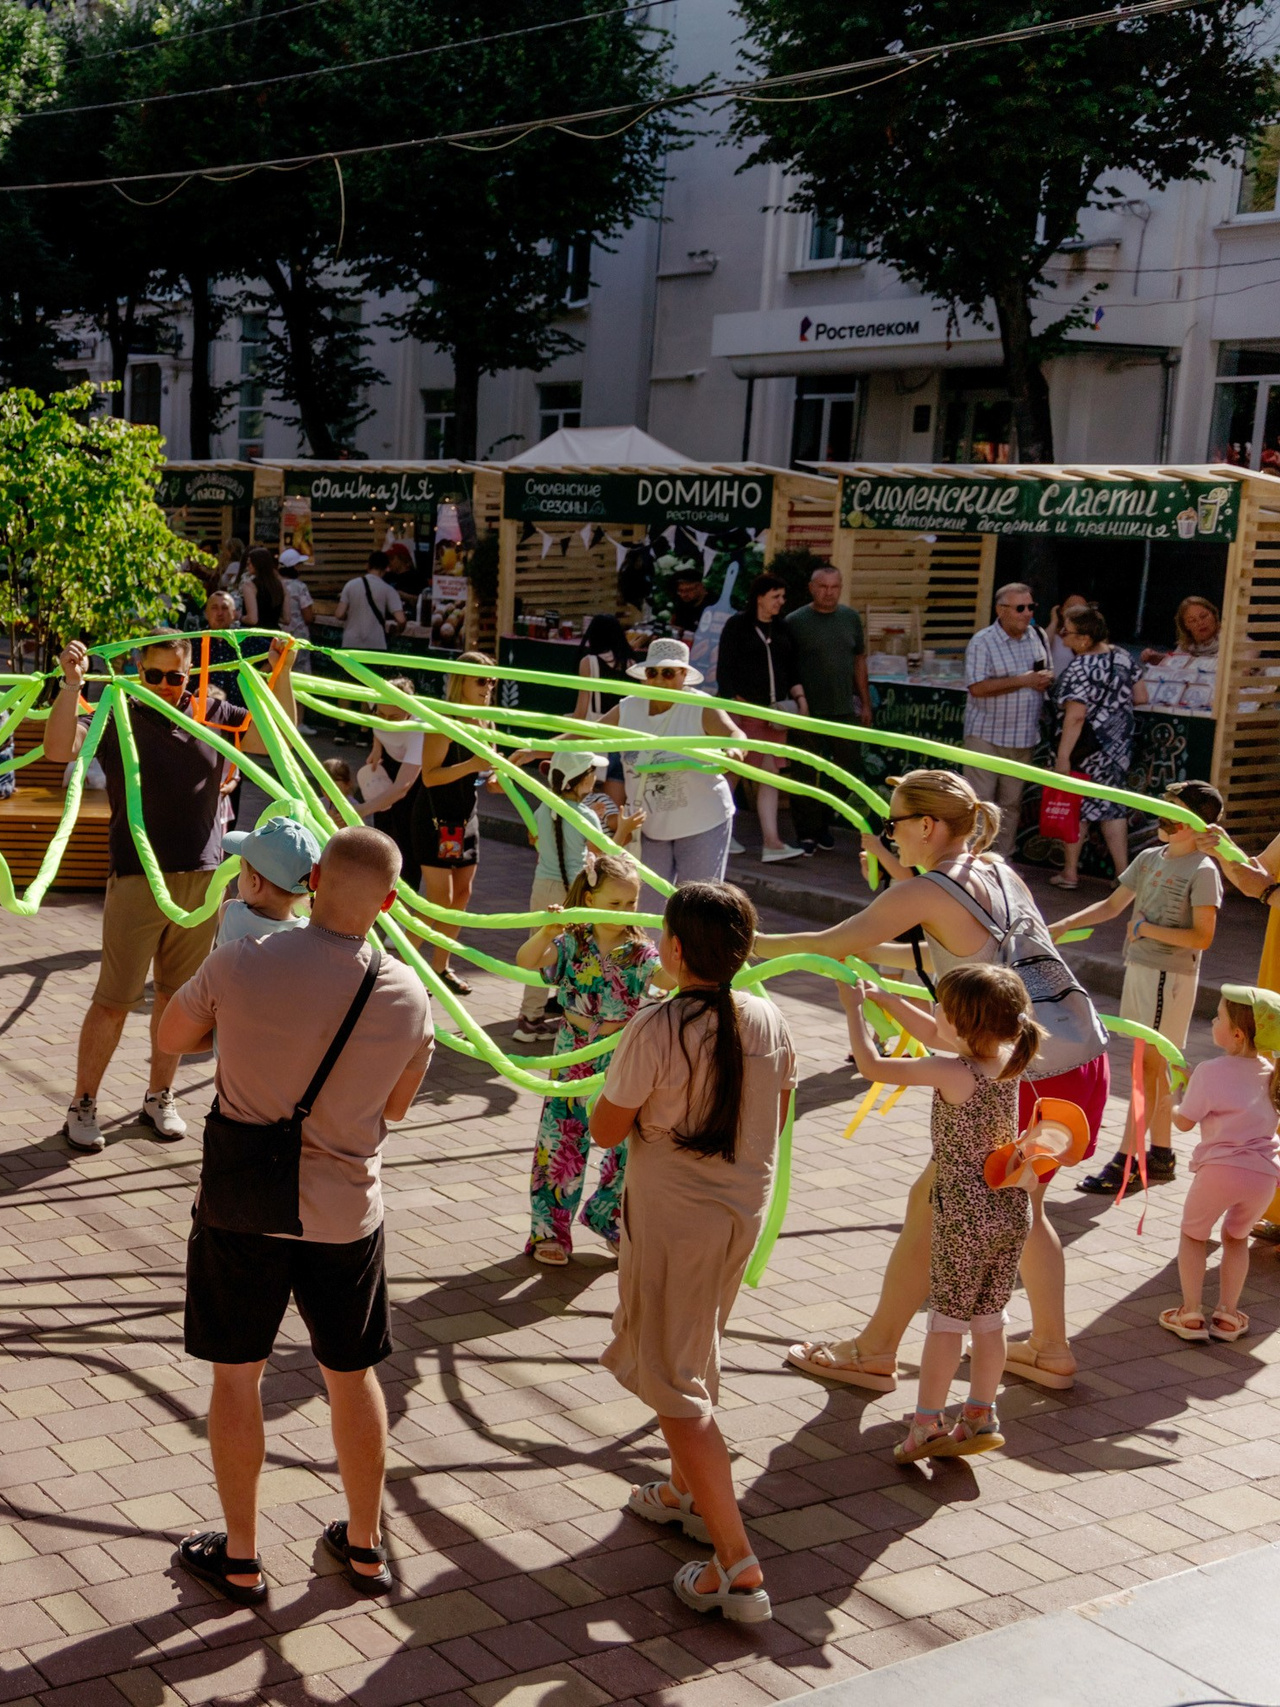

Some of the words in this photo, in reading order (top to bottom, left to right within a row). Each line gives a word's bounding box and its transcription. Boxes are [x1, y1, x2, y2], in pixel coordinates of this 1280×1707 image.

[815, 321, 920, 341] Ростелеком
[311, 473, 435, 510] Фантазия
[525, 477, 602, 498] Смоленские
[853, 479, 1019, 516] Смоленские
[1038, 482, 1158, 517] Сласти
[539, 499, 588, 515] сезоны
[892, 509, 968, 531] авторские
[977, 515, 1051, 535] десерты
[1055, 520, 1067, 533] и
